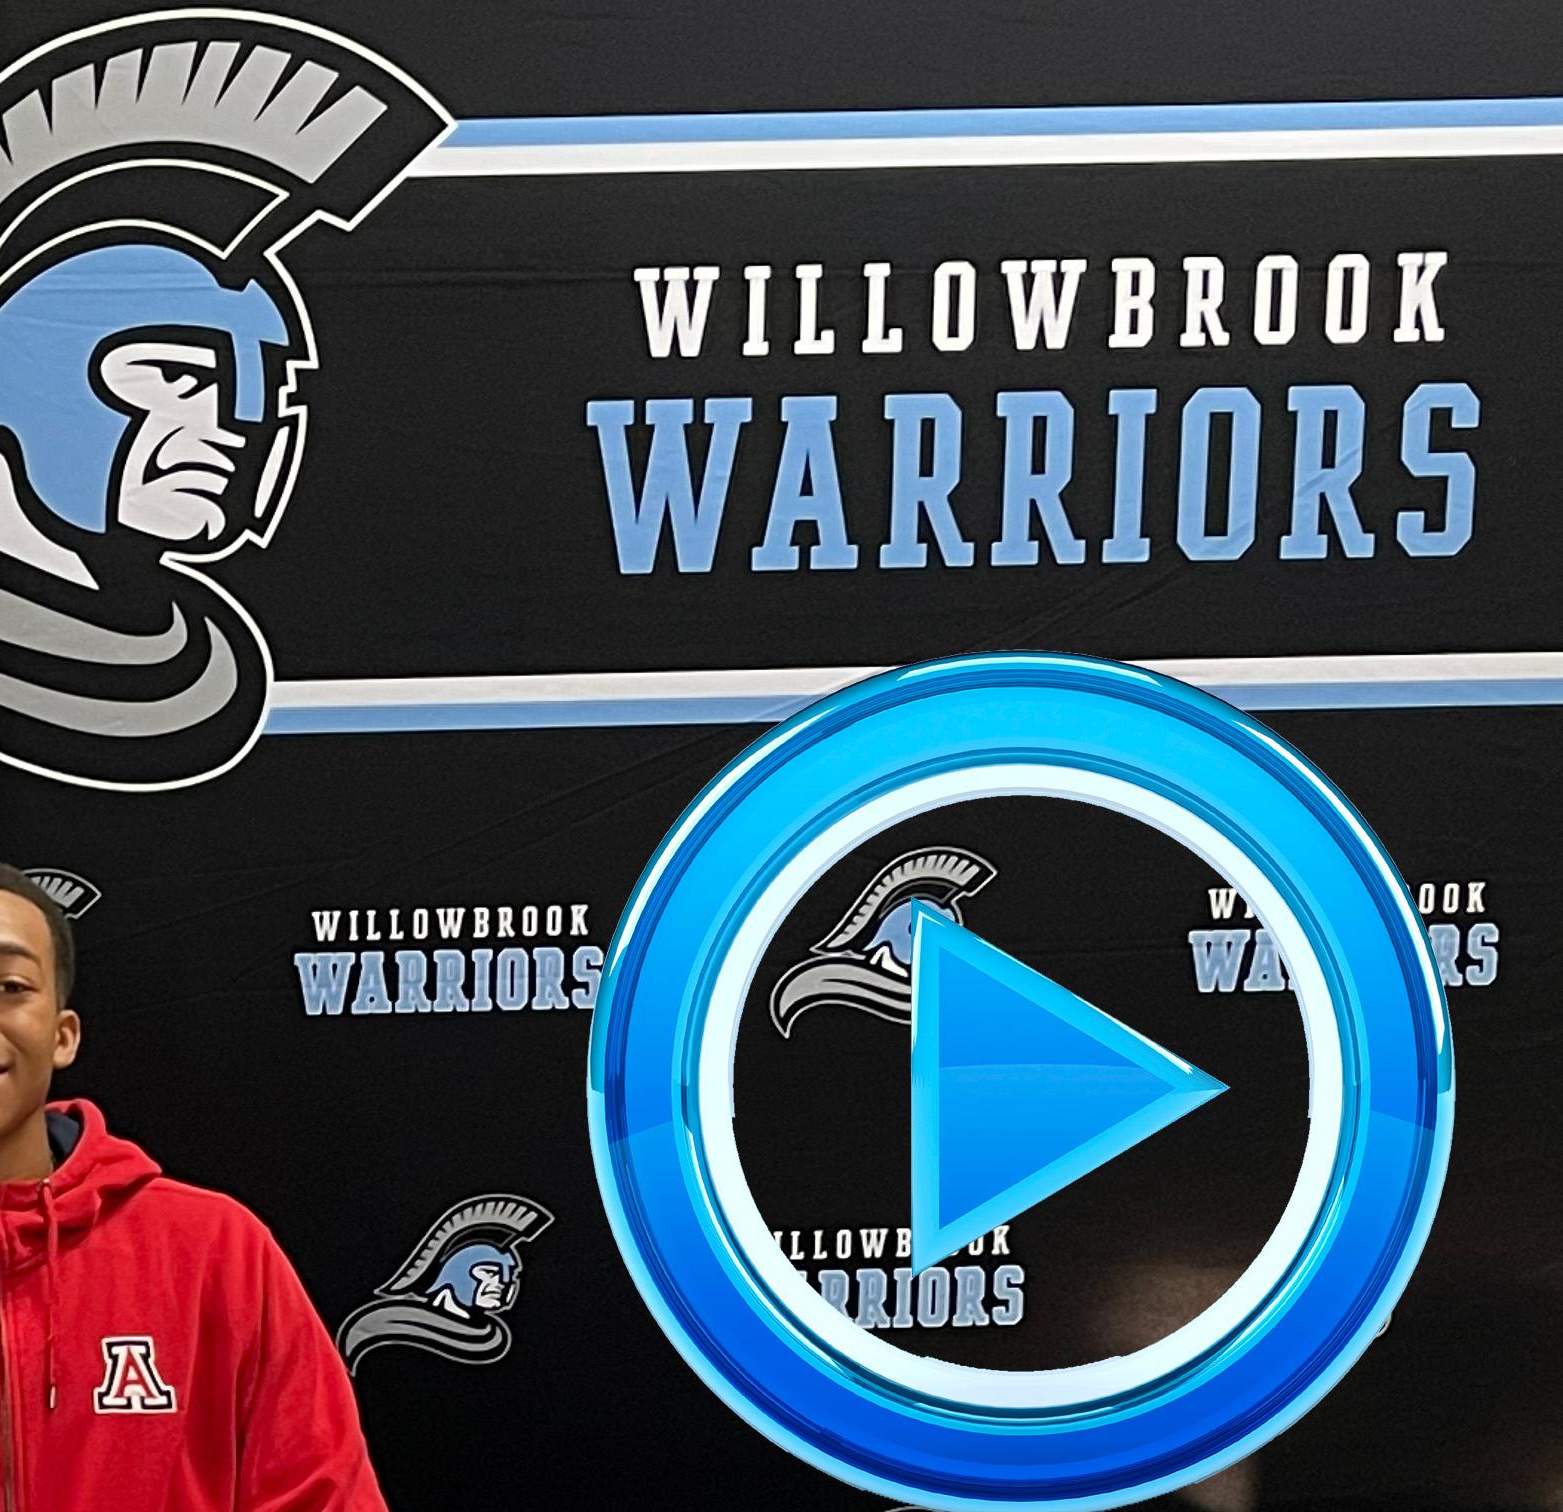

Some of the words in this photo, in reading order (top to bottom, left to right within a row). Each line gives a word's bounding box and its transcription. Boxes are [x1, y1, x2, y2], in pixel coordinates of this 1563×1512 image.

[634, 251, 1447, 357] WILLOWBROOK
[586, 382, 1480, 574] WARRIORS
[311, 904, 589, 941] WILLOWBROOK
[294, 945, 604, 1015] WARRIORS
[1188, 923, 1500, 993] WARS
[794, 1265, 1025, 1329] RRIORS
[93, 1336, 177, 1414] A
